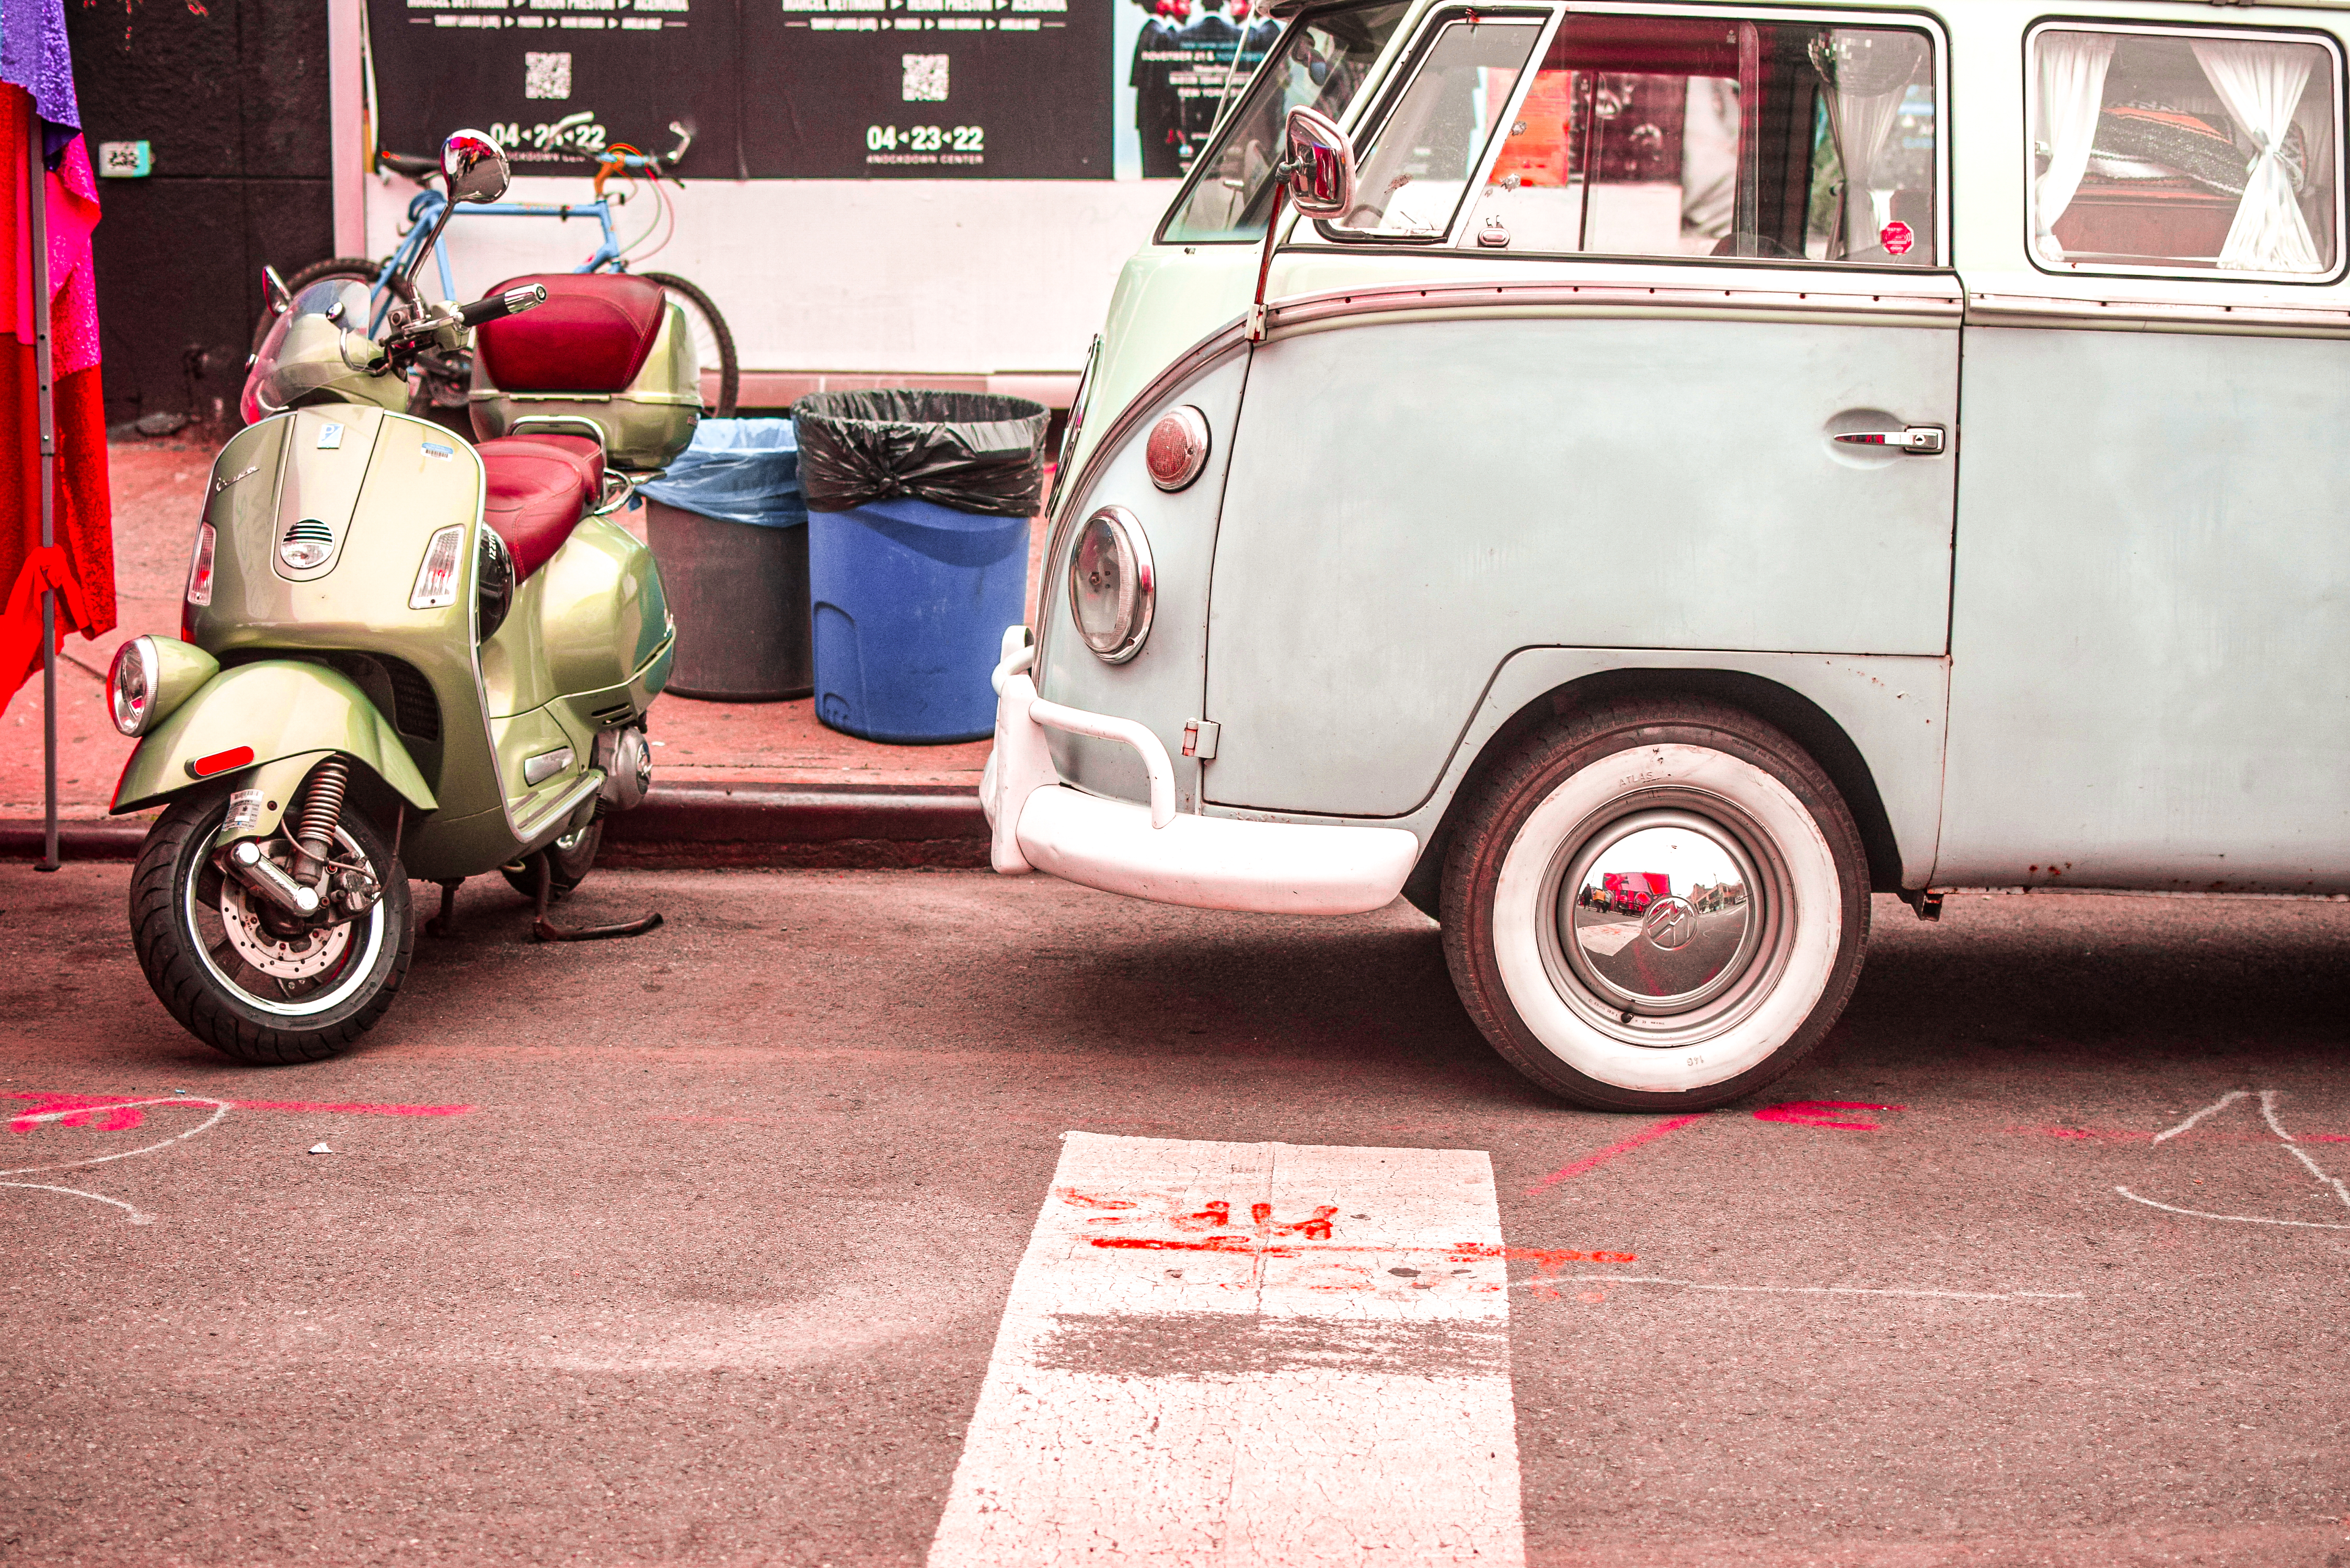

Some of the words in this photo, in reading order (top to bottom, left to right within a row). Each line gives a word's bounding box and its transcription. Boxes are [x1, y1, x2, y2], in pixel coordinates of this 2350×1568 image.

[490, 122, 521, 147] 04
[575, 124, 606, 149] 22
[866, 125, 897, 151] 04
[911, 125, 942, 151] 23
[952, 125, 984, 152] 22
[939, 154, 984, 164] CENTER
[1619, 771, 1653, 787] ATLAS
